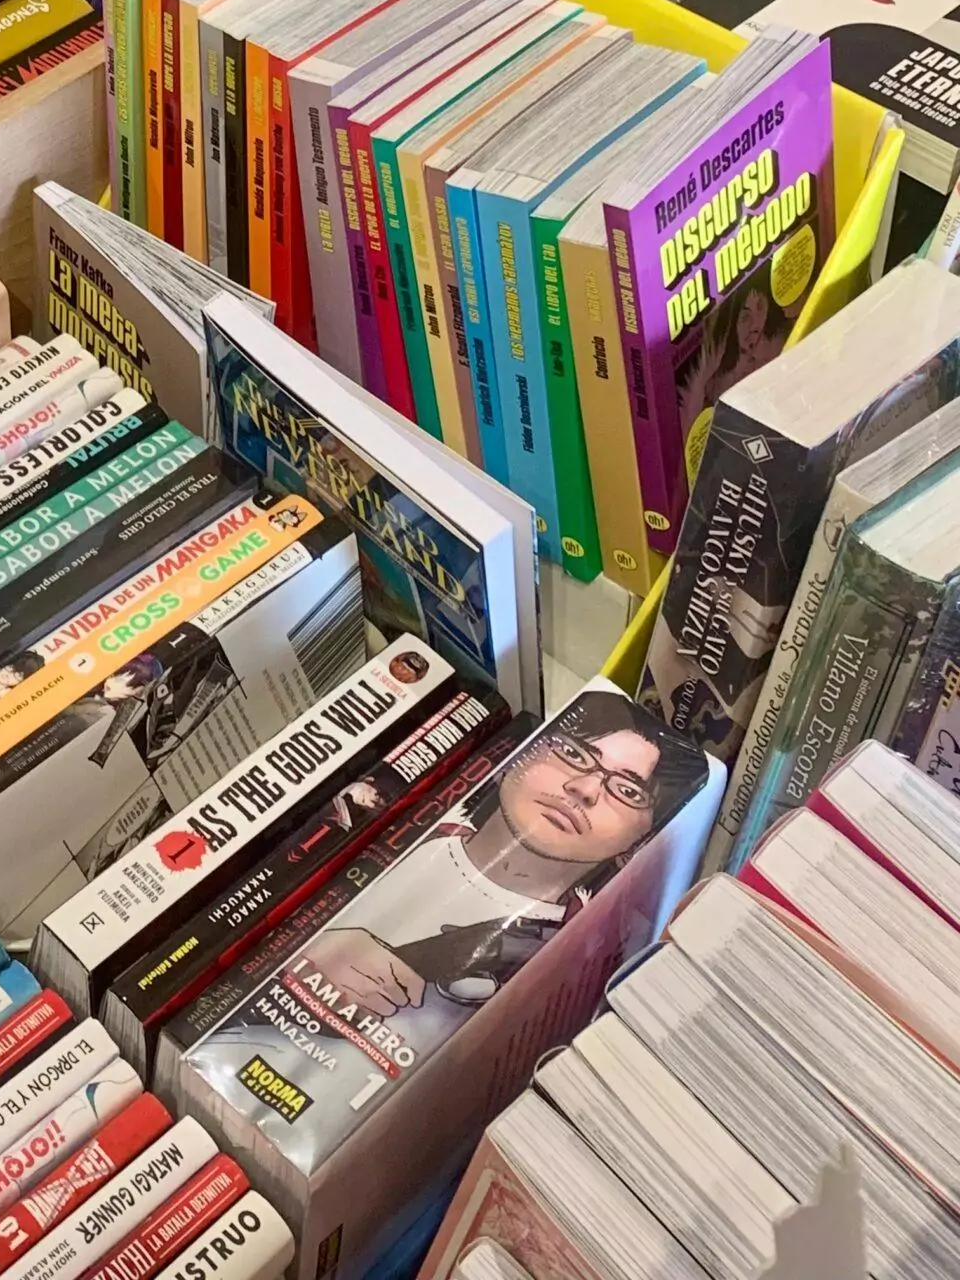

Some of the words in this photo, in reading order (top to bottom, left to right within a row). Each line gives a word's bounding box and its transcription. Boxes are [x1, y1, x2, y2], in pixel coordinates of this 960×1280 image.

[308, 106, 326, 166] Testamento
[316, 165, 330, 206] Antiguo
[654, 171, 697, 234] René
[699, 100, 785, 193] Descartes
[49, 226, 79, 270] Franz
[81, 253, 114, 301] Kafka
[423, 284, 438, 312] Milton
[429, 312, 441, 340] John
[593, 335, 610, 381] Confucio
[64, 490, 87, 507] A
[86, 426, 180, 492] MELON
[83, 506, 107, 526] A
[107, 443, 198, 507] MELON
[565, 538, 581, 557] oh!
[700, 478, 743, 573] BLANCO
[42, 637, 68, 655] LA
[63, 600, 121, 643] VIDA
[111, 587, 133, 607] DE
[127, 573, 156, 596] UN
[152, 503, 258, 585] MANGAKA
[97, 592, 183, 654] CROSS
[198, 529, 269, 583] GAME
[197, 546, 305, 629] KAKEGURUI
[676, 572, 718, 657] SHIZUN
[818, 632, 869, 713] Villano
[854, 680, 875, 712] sistema
[867, 665, 877, 681] El
[326, 678, 399, 744] WILL
[848, 710, 859, 724] de
[275, 720, 346, 786] GODS
[786, 713, 837, 801] Escoria
[216, 764, 283, 826] THE
[194, 804, 240, 855] AS
[96, 888, 132, 925] FUJIMURA
[121, 865, 160, 906] KANESHIRO
[208, 867, 275, 925] TAKAKUCHI
[139, 961, 169, 990] Editorial
[168, 936, 200, 966] NORMA
[11, 1001, 57, 1041] DEFINITIVA
[255, 996, 339, 1072] HANAZAWA
[268, 983, 322, 1035] KENGO
[246, 1059, 308, 1113] NORMA
[136, 1141, 185, 1187] MATAGI
[81, 1178, 141, 1246] GUNNER
